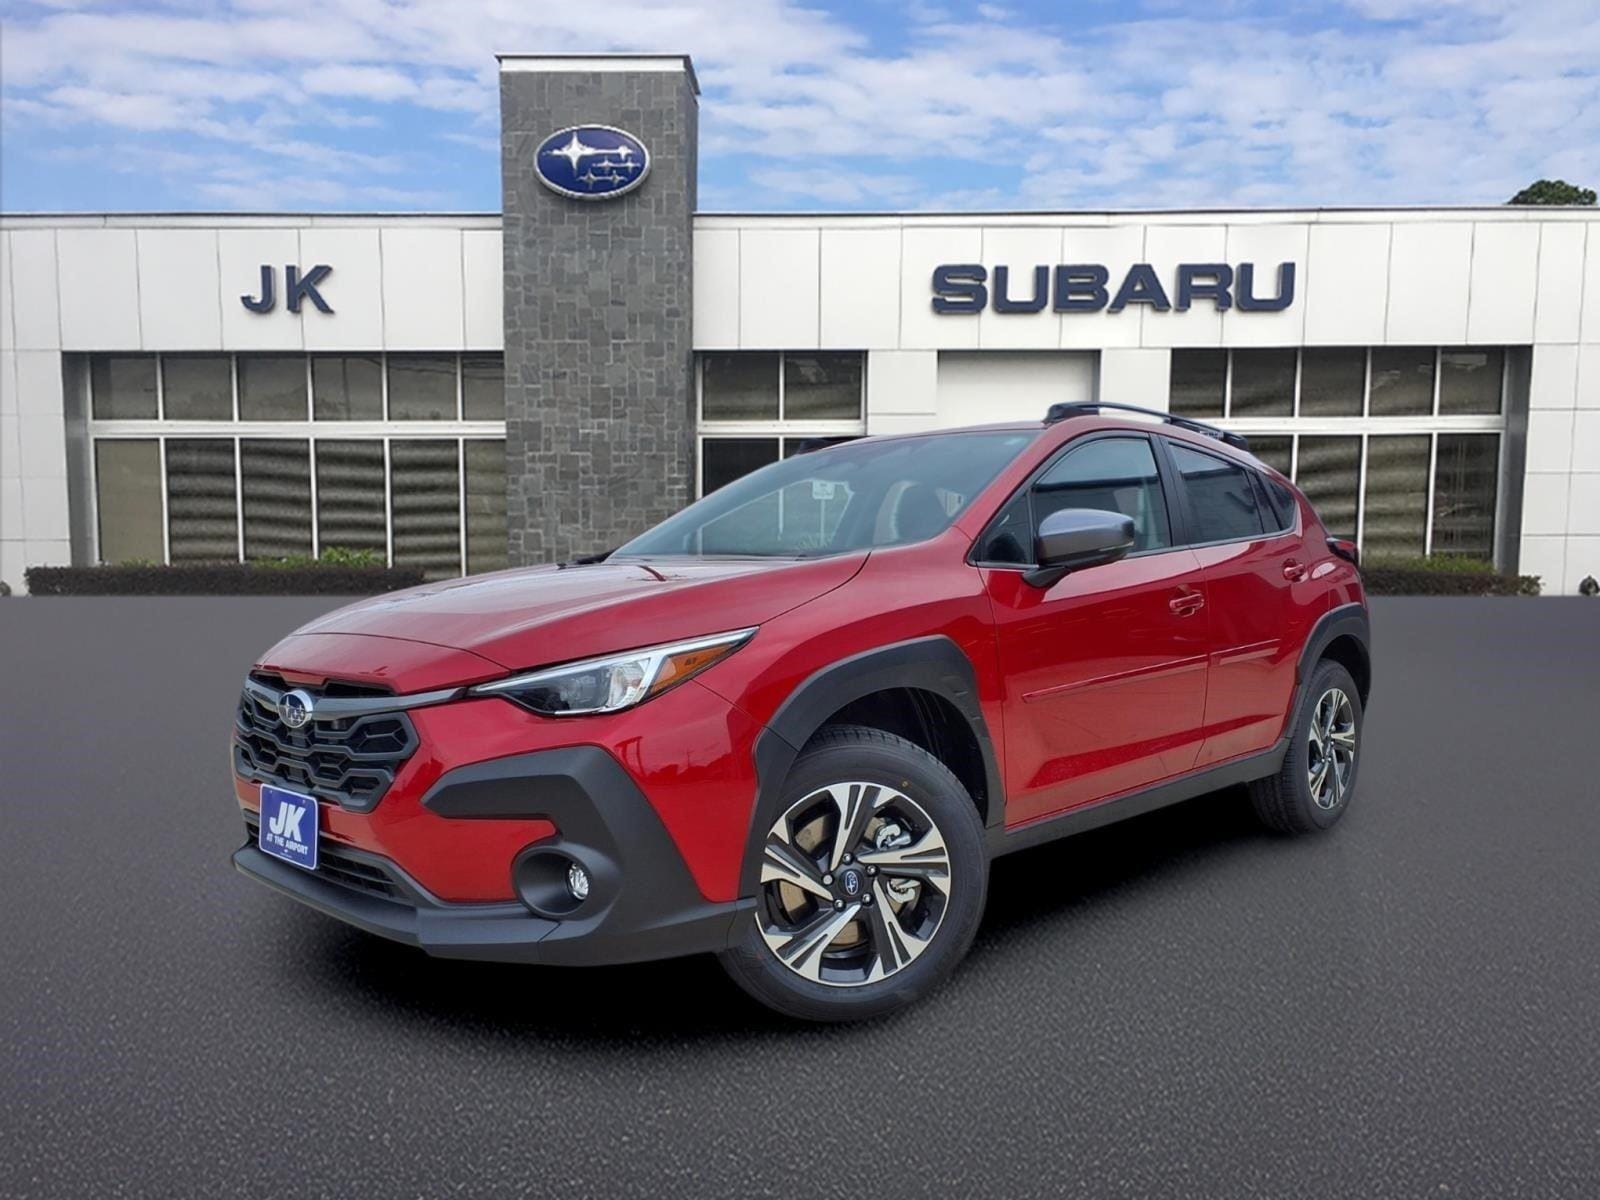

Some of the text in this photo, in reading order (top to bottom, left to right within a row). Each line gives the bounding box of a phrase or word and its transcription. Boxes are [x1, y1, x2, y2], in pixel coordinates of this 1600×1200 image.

[241, 264, 334, 314] JK
[931, 262, 1296, 314] SUBARU
[269, 801, 306, 842] JK
[285, 840, 308, 855] AIRPORT
